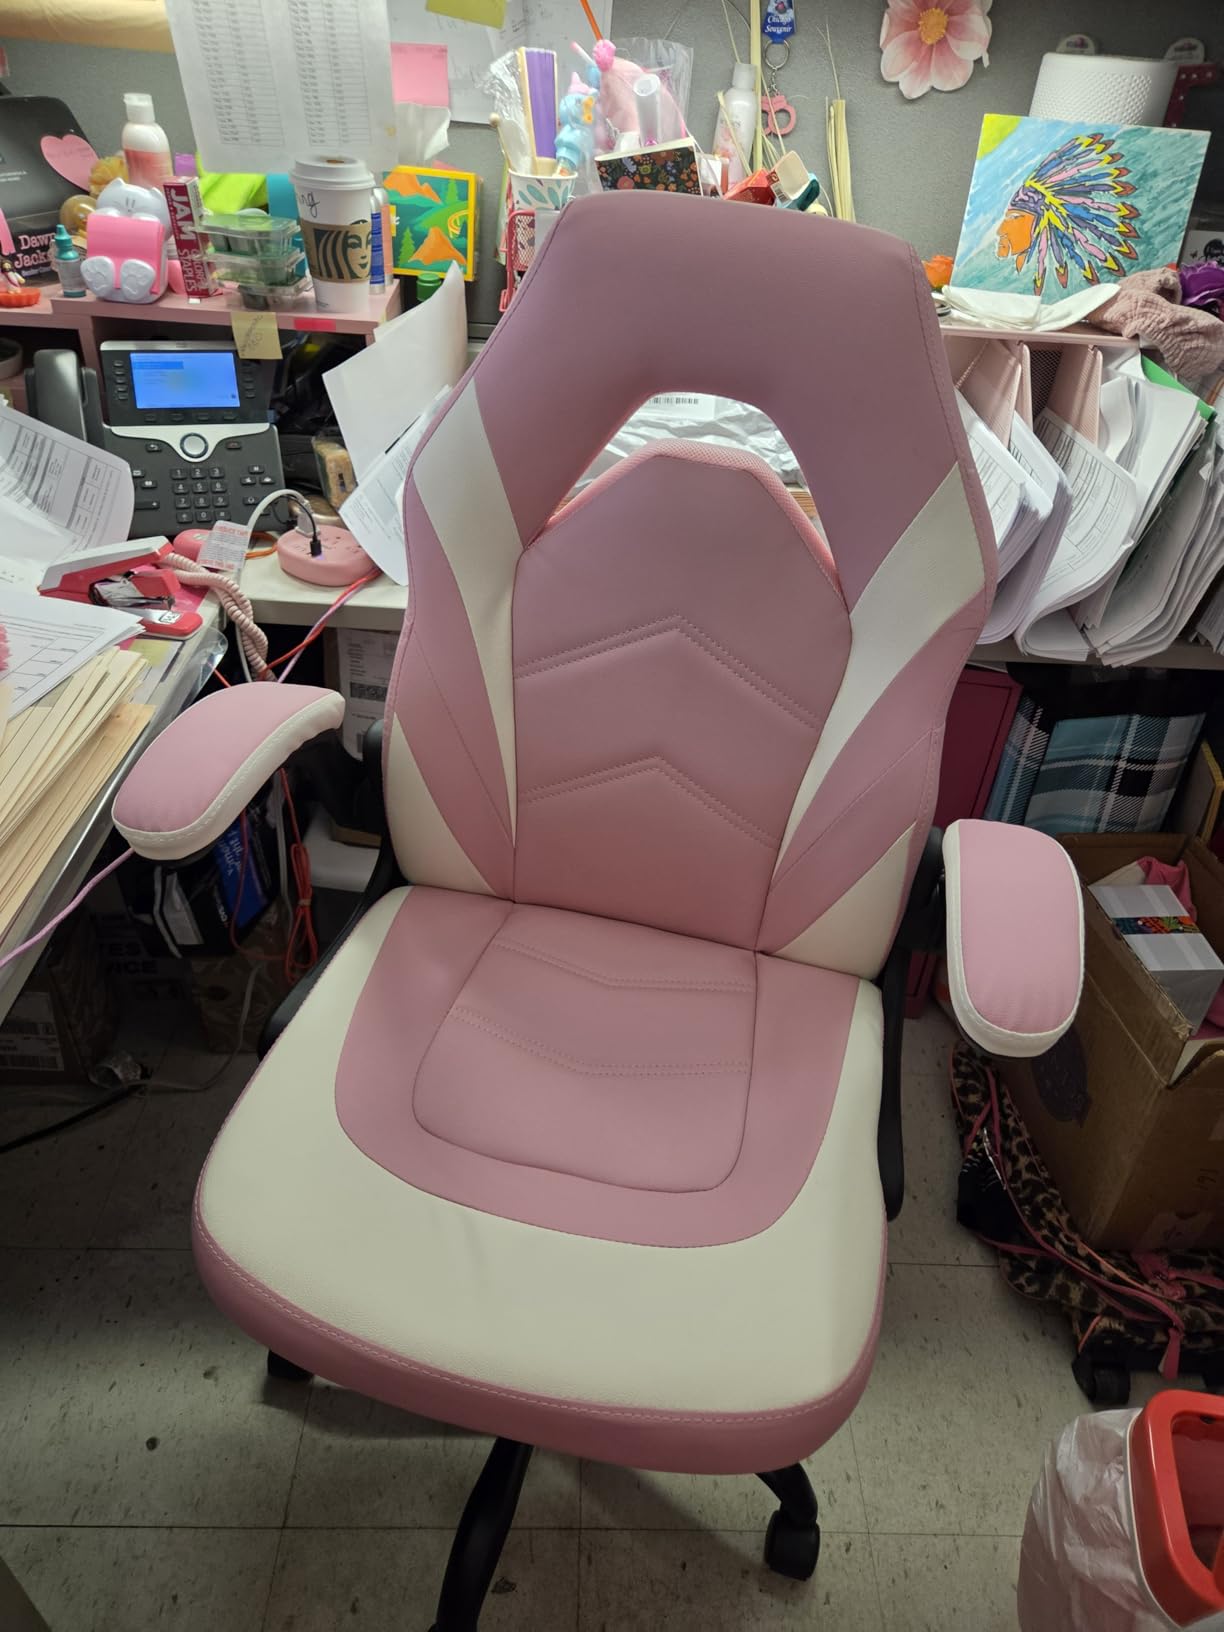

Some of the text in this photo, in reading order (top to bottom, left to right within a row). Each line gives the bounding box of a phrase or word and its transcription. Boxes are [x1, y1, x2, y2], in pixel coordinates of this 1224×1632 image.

[765, 25, 792, 34] Souvenir
[170, 187, 197, 241] JAM
[178, 248, 198, 292] STAPLES
